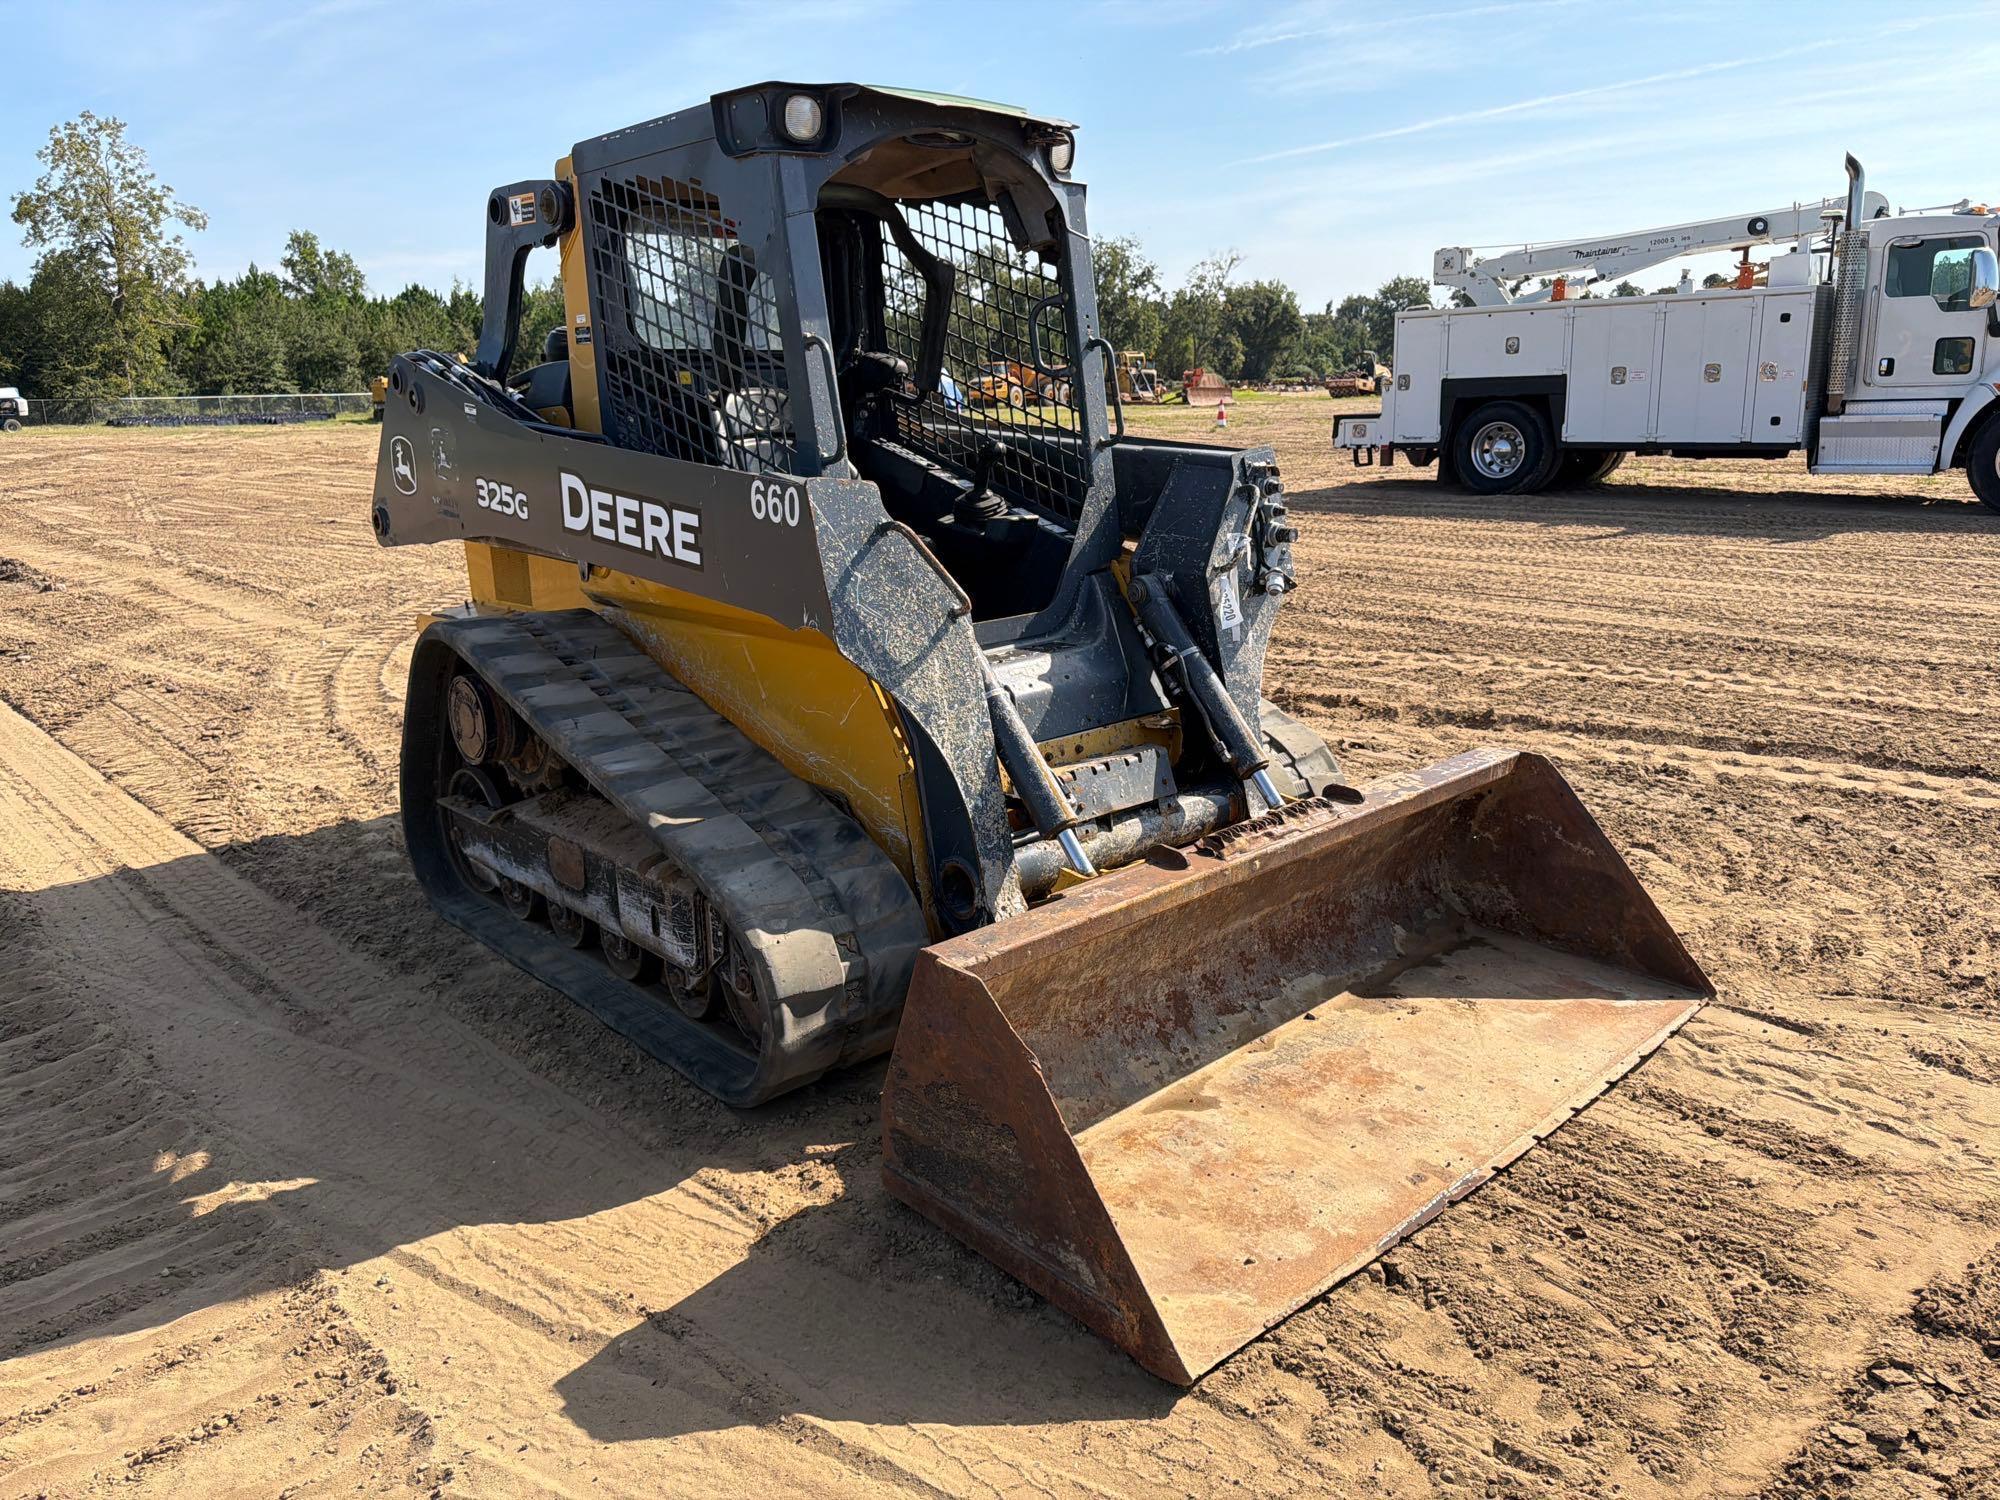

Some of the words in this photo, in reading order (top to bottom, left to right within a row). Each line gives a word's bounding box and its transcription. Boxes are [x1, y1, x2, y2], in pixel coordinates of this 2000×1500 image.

[1568, 245, 1630, 260] Maintainer
[1649, 237, 1669, 247] 12000
[476, 478, 528, 520] 325G
[560, 472, 701, 566] DEERE
[750, 479, 800, 527] 660
